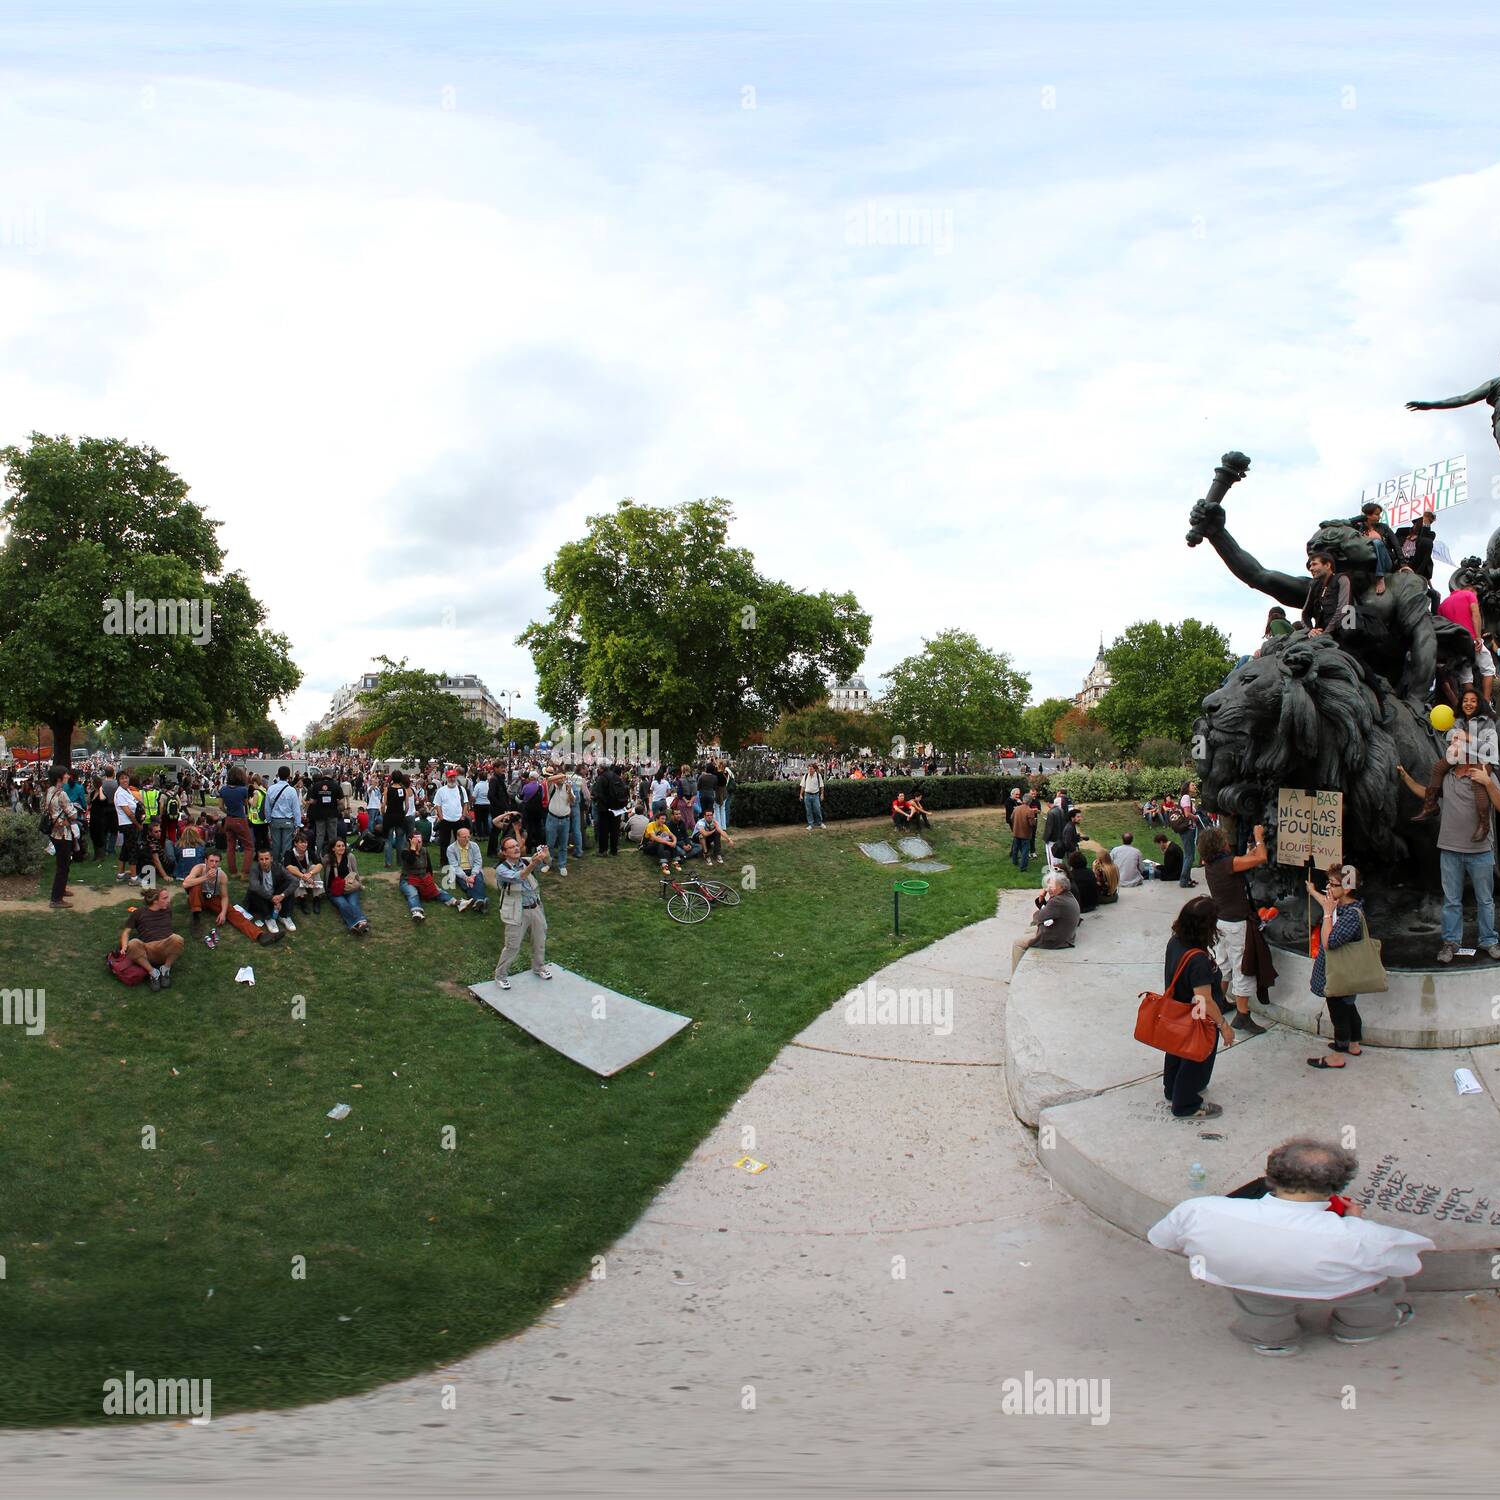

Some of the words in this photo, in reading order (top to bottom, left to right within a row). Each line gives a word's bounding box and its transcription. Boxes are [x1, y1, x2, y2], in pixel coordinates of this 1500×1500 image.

[1317, 791, 1338, 807] BAS
[1395, 1182, 1424, 1214] POUR
[1433, 1187, 1475, 1221] CHIER
